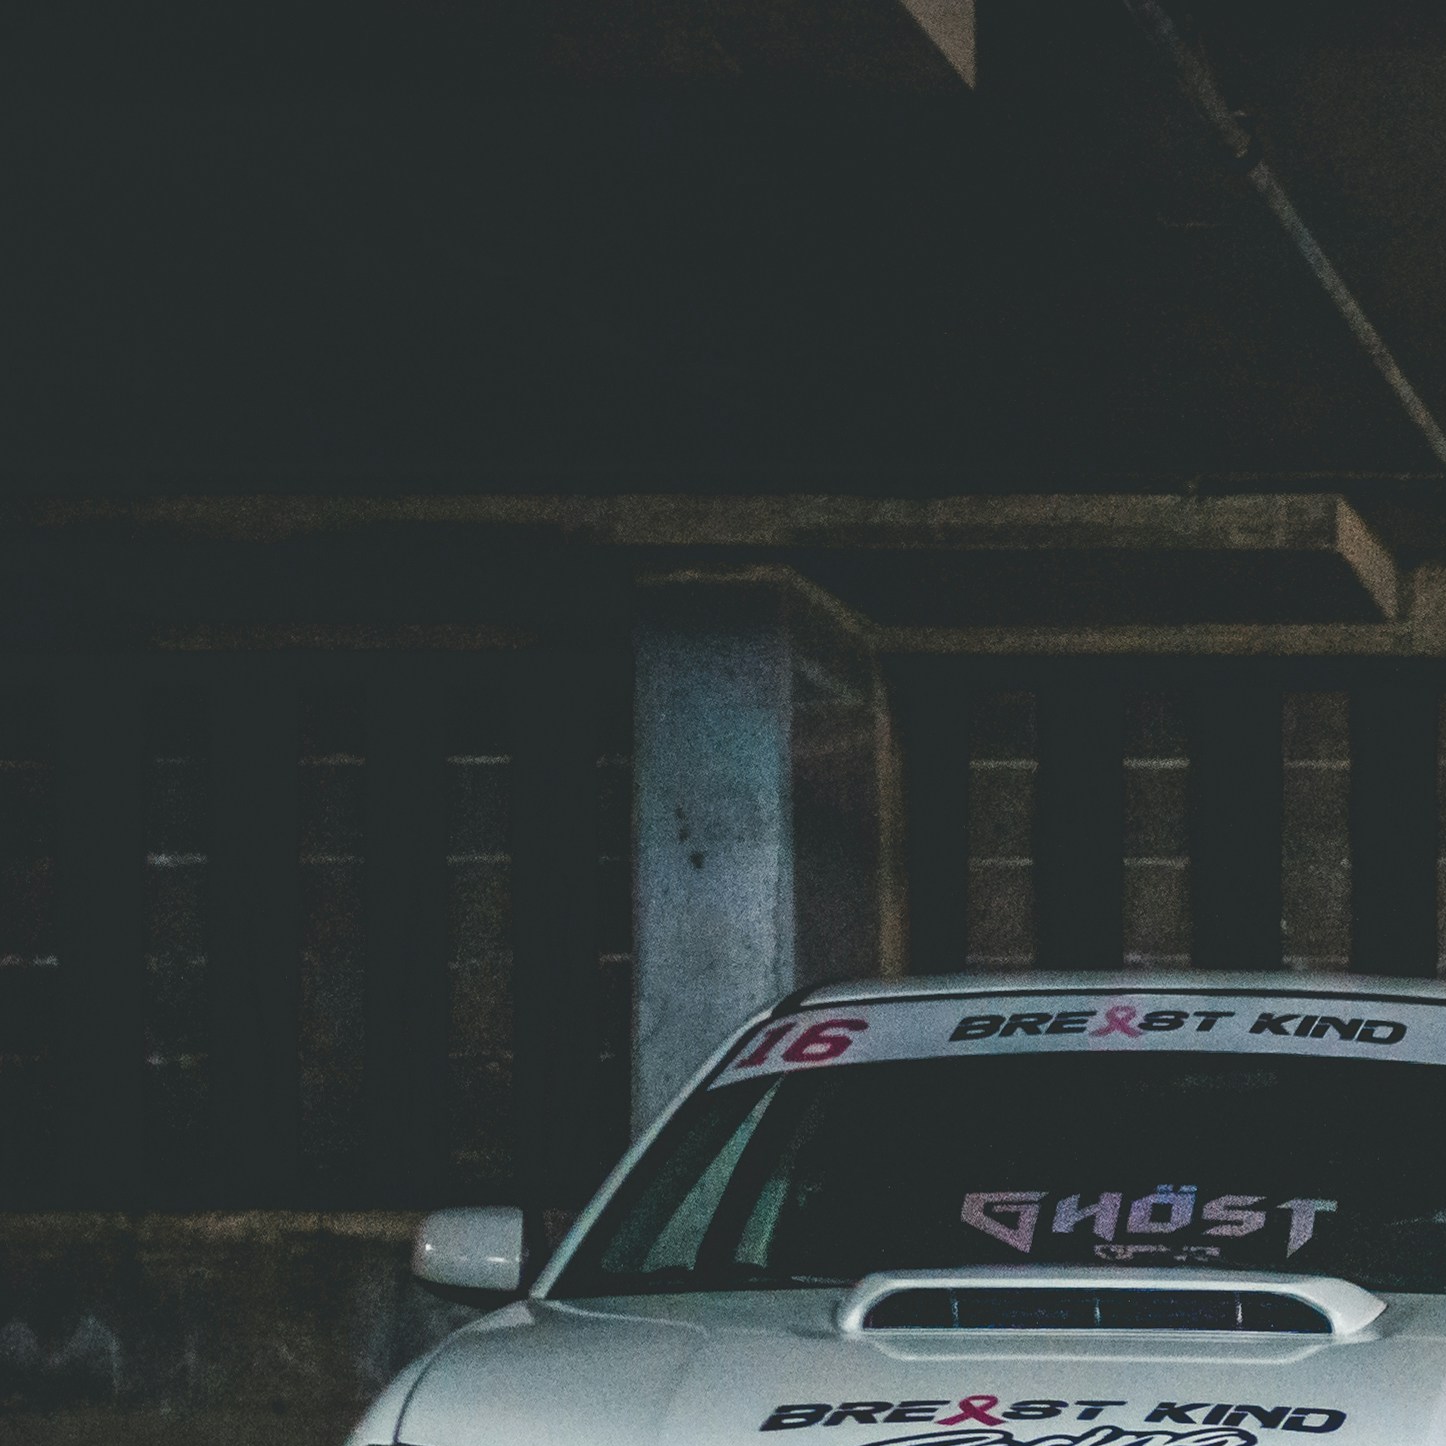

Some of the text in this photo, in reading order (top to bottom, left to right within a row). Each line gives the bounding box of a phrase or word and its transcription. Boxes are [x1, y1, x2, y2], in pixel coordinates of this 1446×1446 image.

[735, 1017, 870, 1069] 16
[1248, 1012, 1408, 1046] KIND
[1145, 1400, 1348, 1435] KIND
